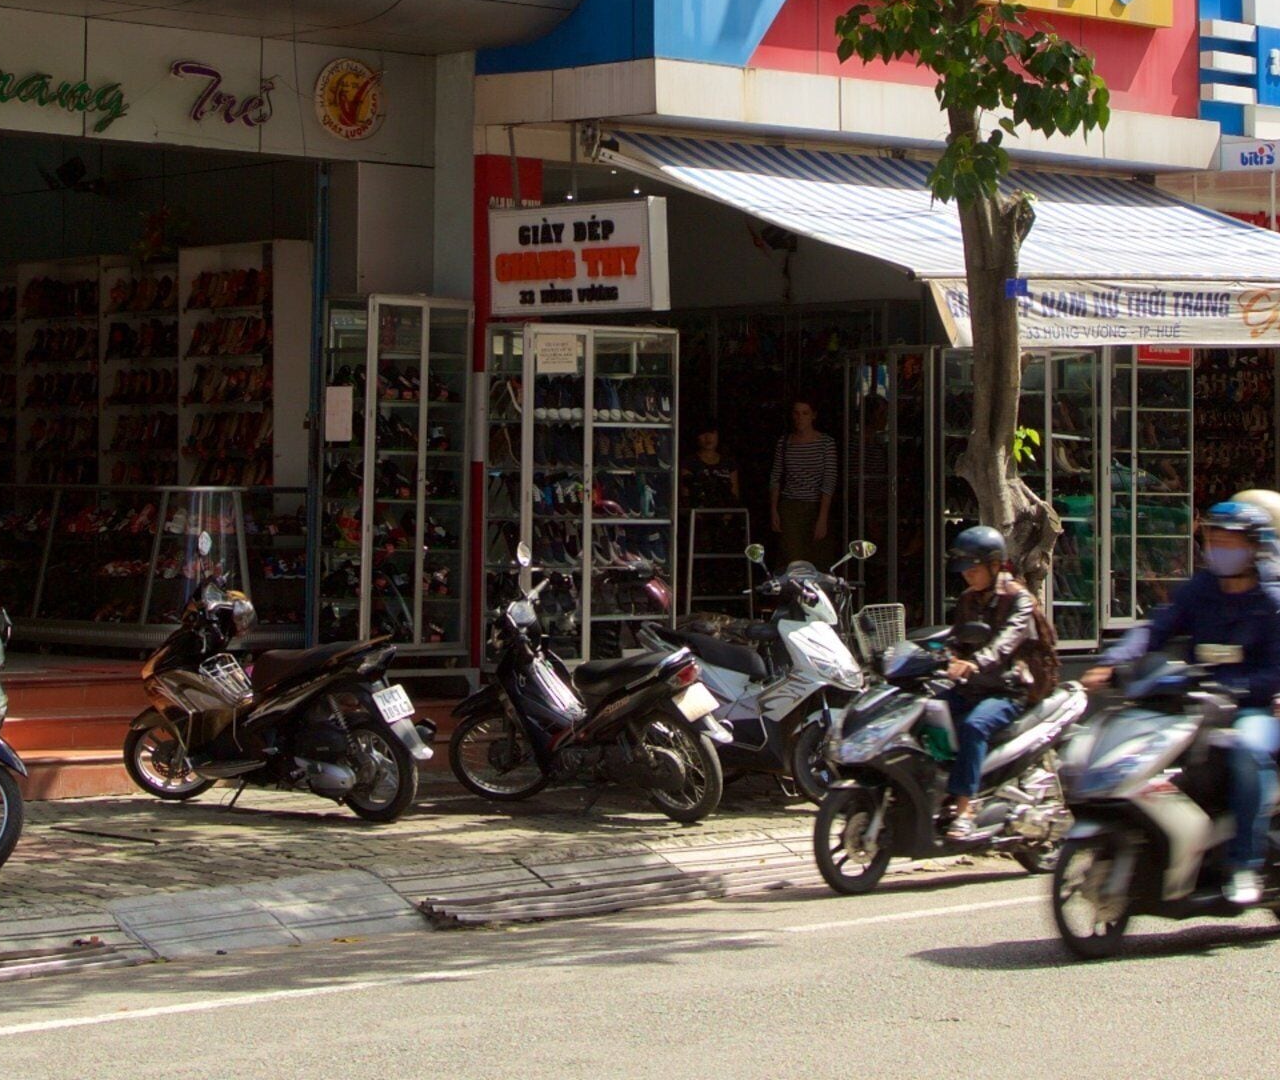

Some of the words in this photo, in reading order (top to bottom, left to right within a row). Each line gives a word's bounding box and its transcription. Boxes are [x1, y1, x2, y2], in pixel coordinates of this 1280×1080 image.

[519, 217, 565, 246] GIÀY
[573, 214, 615, 243] DÉP
[581, 245, 641, 278] THY
[519, 289, 536, 305] 33
[1041, 292, 1087, 319] NAM
[1125, 289, 1170, 318] THỜI
[1171, 293, 1232, 317] TRANG
